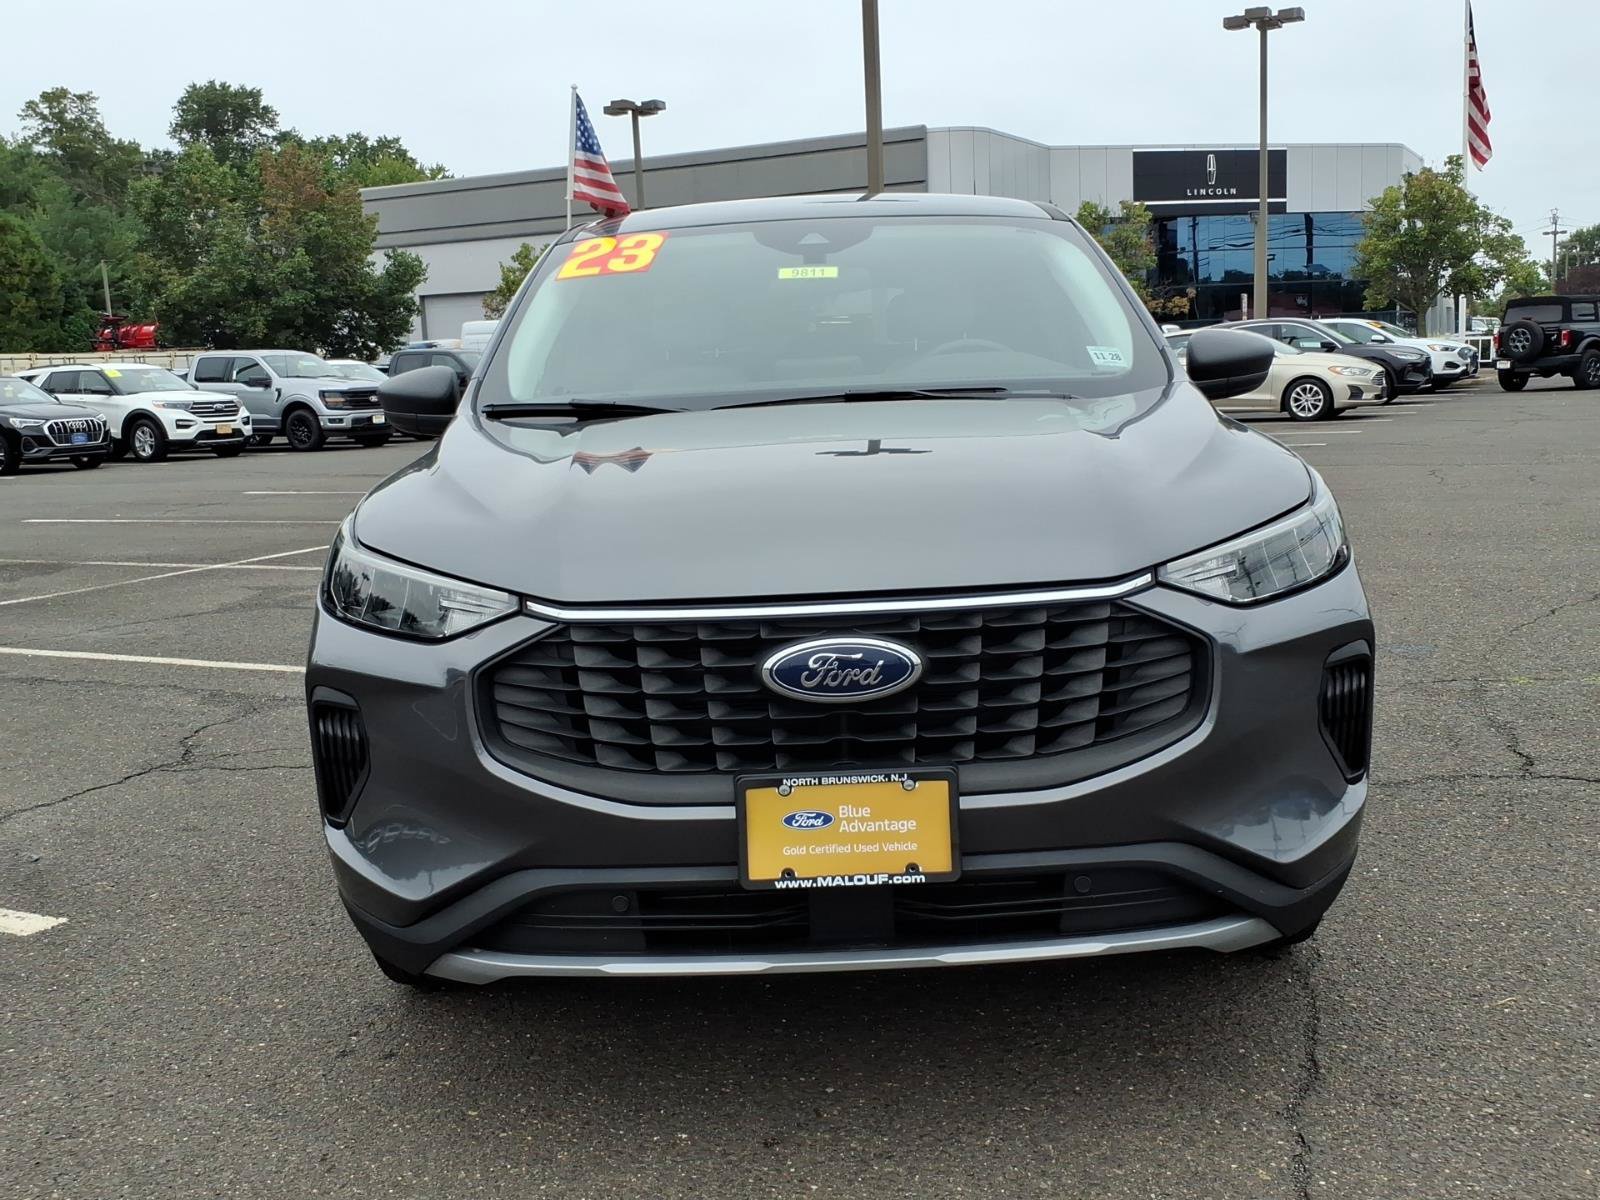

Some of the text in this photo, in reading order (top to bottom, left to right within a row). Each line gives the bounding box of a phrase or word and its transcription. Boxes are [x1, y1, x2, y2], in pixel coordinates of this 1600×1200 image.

[1187, 188, 1237, 196] LINCOLN
[556, 232, 667, 280] 23
[791, 268, 825, 278] 9811
[800, 652, 885, 688] Ford
[783, 777, 818, 787] NORTH
[839, 805, 871, 818] Blue
[792, 812, 824, 828] Ford
[839, 818, 917, 833] Advantage
[783, 841, 918, 856] Gold Certified Used Vehicle
[774, 873, 926, 890] www.MALOUF.com
